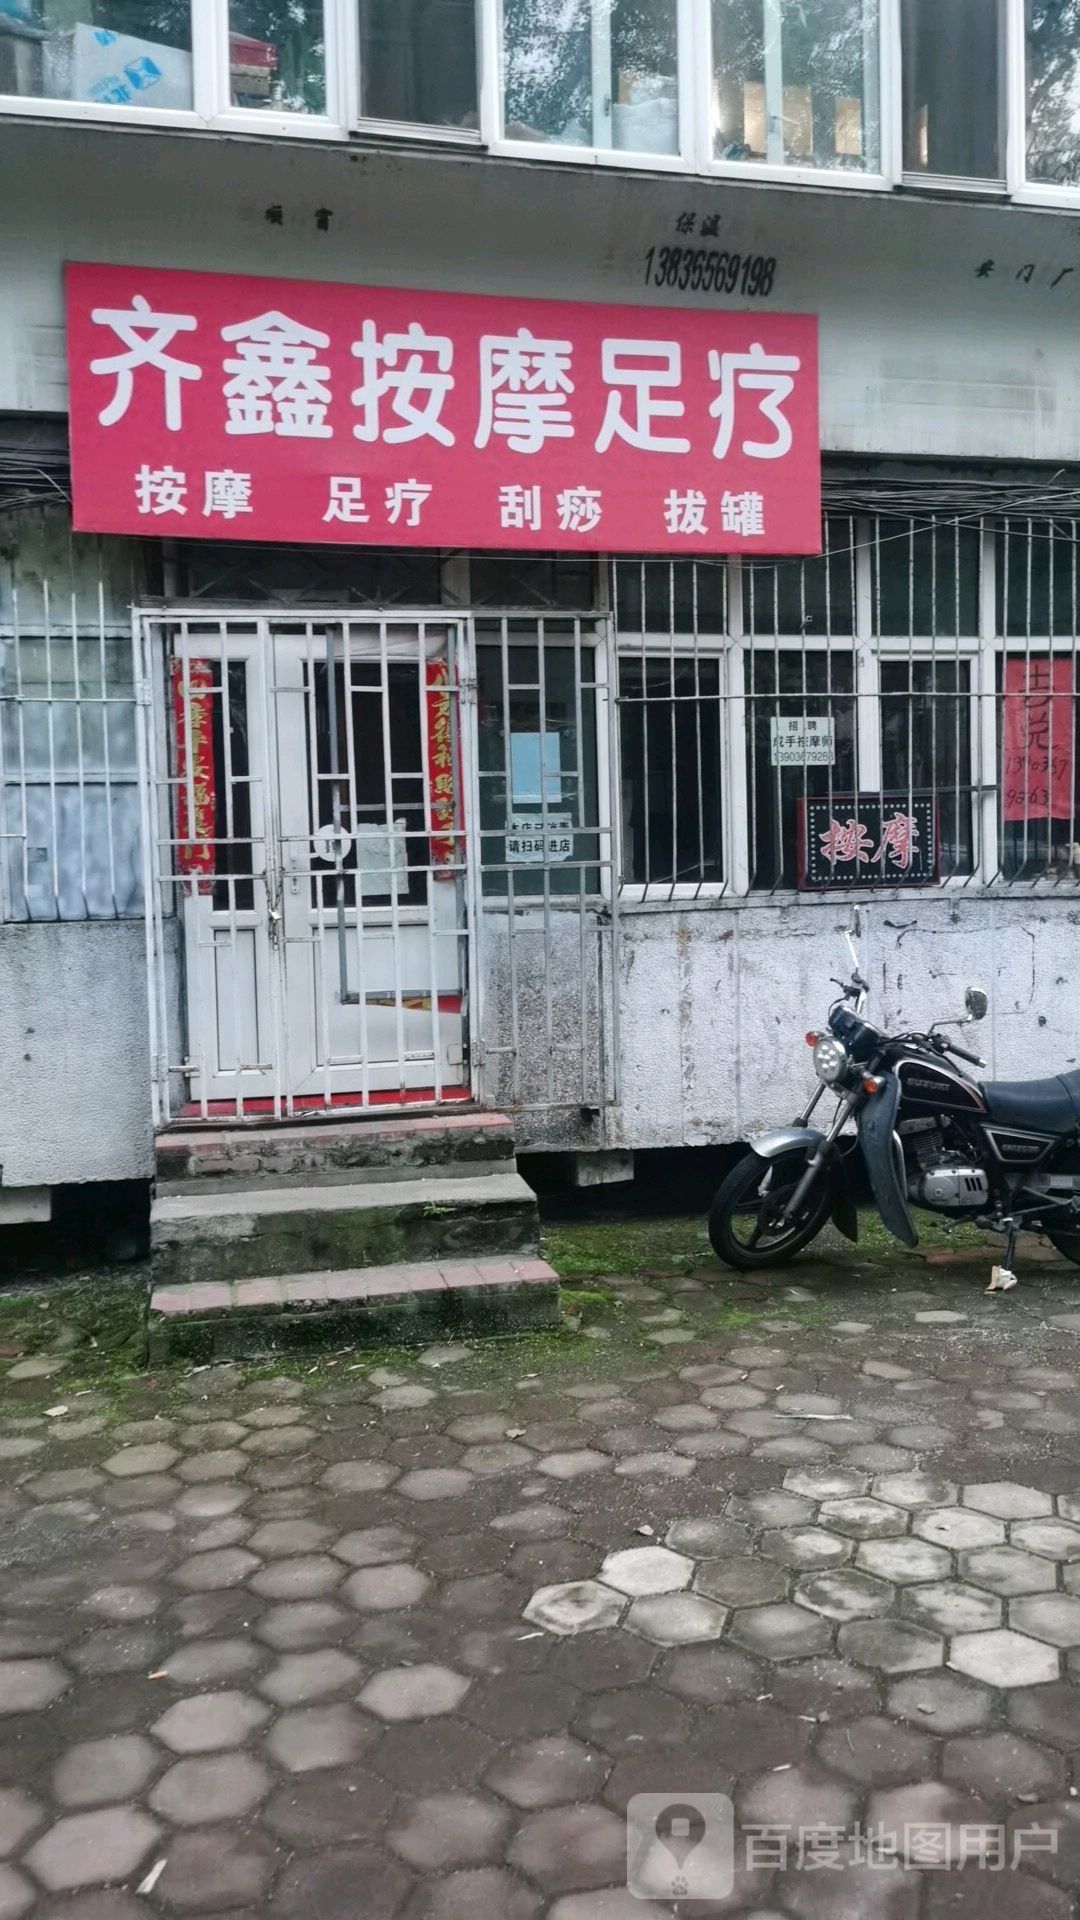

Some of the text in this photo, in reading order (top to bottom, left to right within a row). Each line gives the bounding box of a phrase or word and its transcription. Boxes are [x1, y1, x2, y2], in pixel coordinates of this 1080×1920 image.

[90, 294, 801, 460] 齐鑫按摩足疗
[134, 464, 766, 537] 按摩 足疗 刮痧 拔罐
[508, 838, 571, 853] 请扫码进店
[818, 811, 920, 869] 按摩
